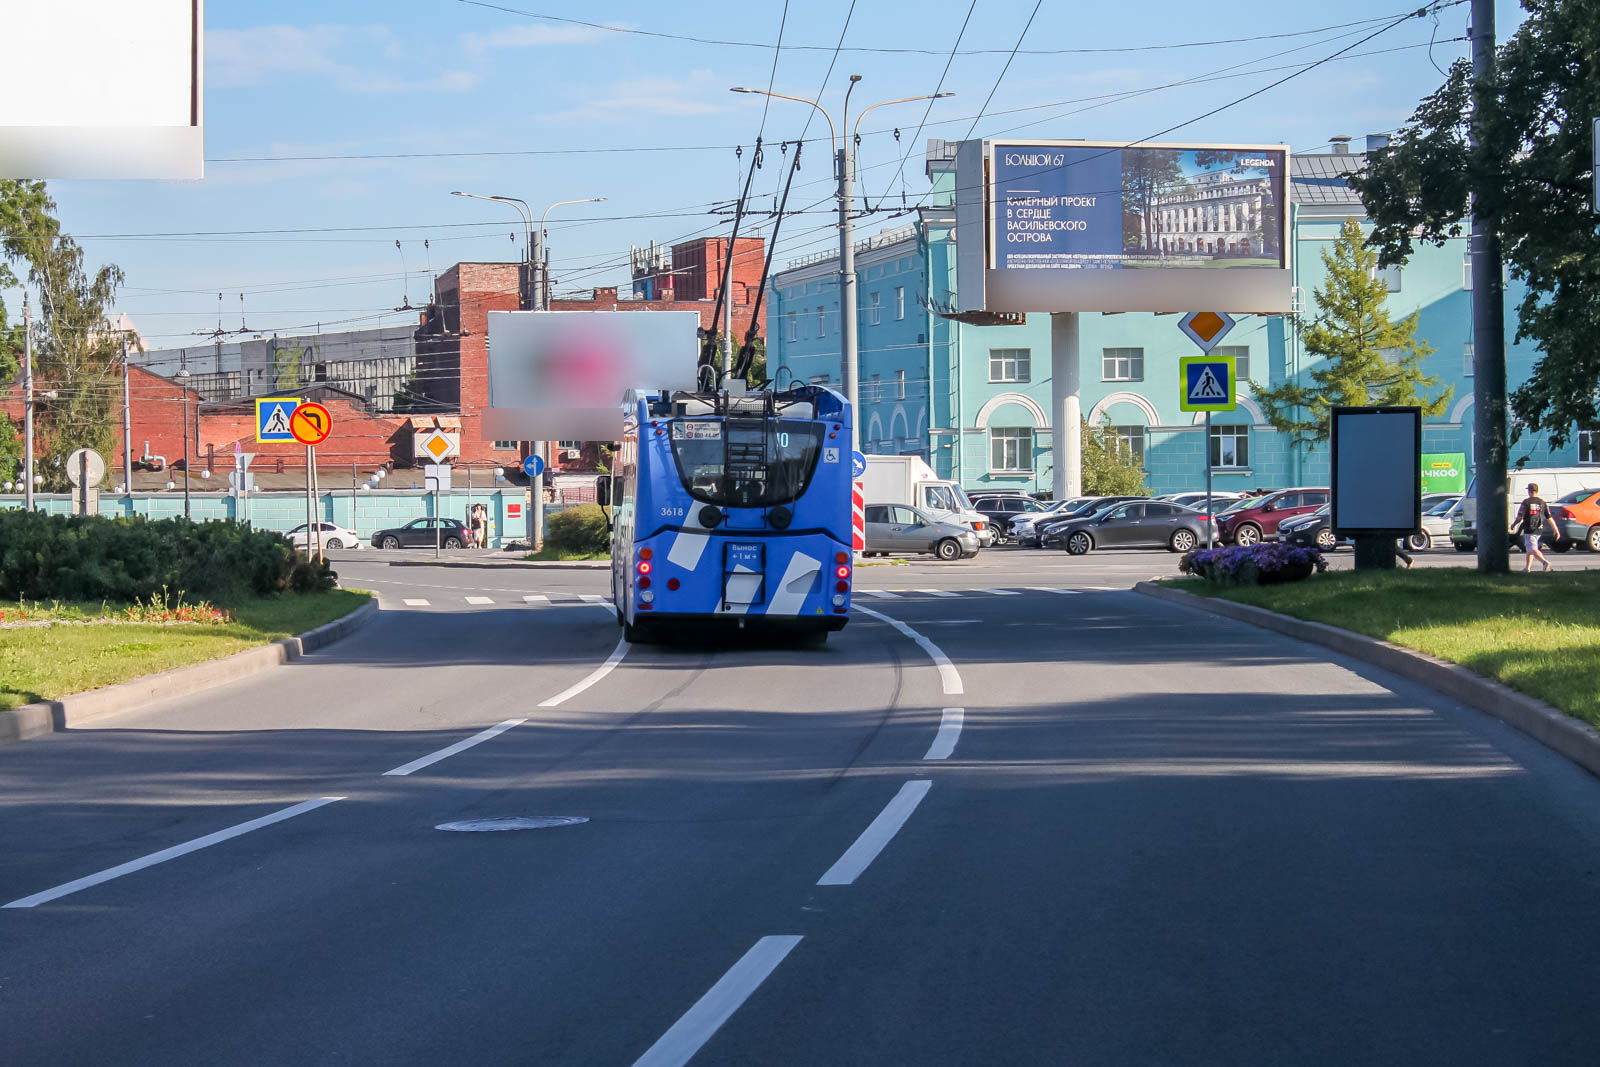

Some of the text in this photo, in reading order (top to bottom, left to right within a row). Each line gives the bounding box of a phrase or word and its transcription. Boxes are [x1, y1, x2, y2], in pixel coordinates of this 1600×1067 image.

[1005, 153, 1065, 166] БОЛЬШОЙ 67
[1240, 158, 1275, 167] LEGENDA
[1007, 195, 1096, 207] КАМЕРНЫЙ ПРОЕКТ
[1007, 208, 1052, 220] В СЕРДЦЕ
[1007, 220, 1087, 231] ВАСИЛЬЕВСКОГО
[1007, 232, 1052, 243] ОСТРОВА
[660, 507, 684, 516] 3618
